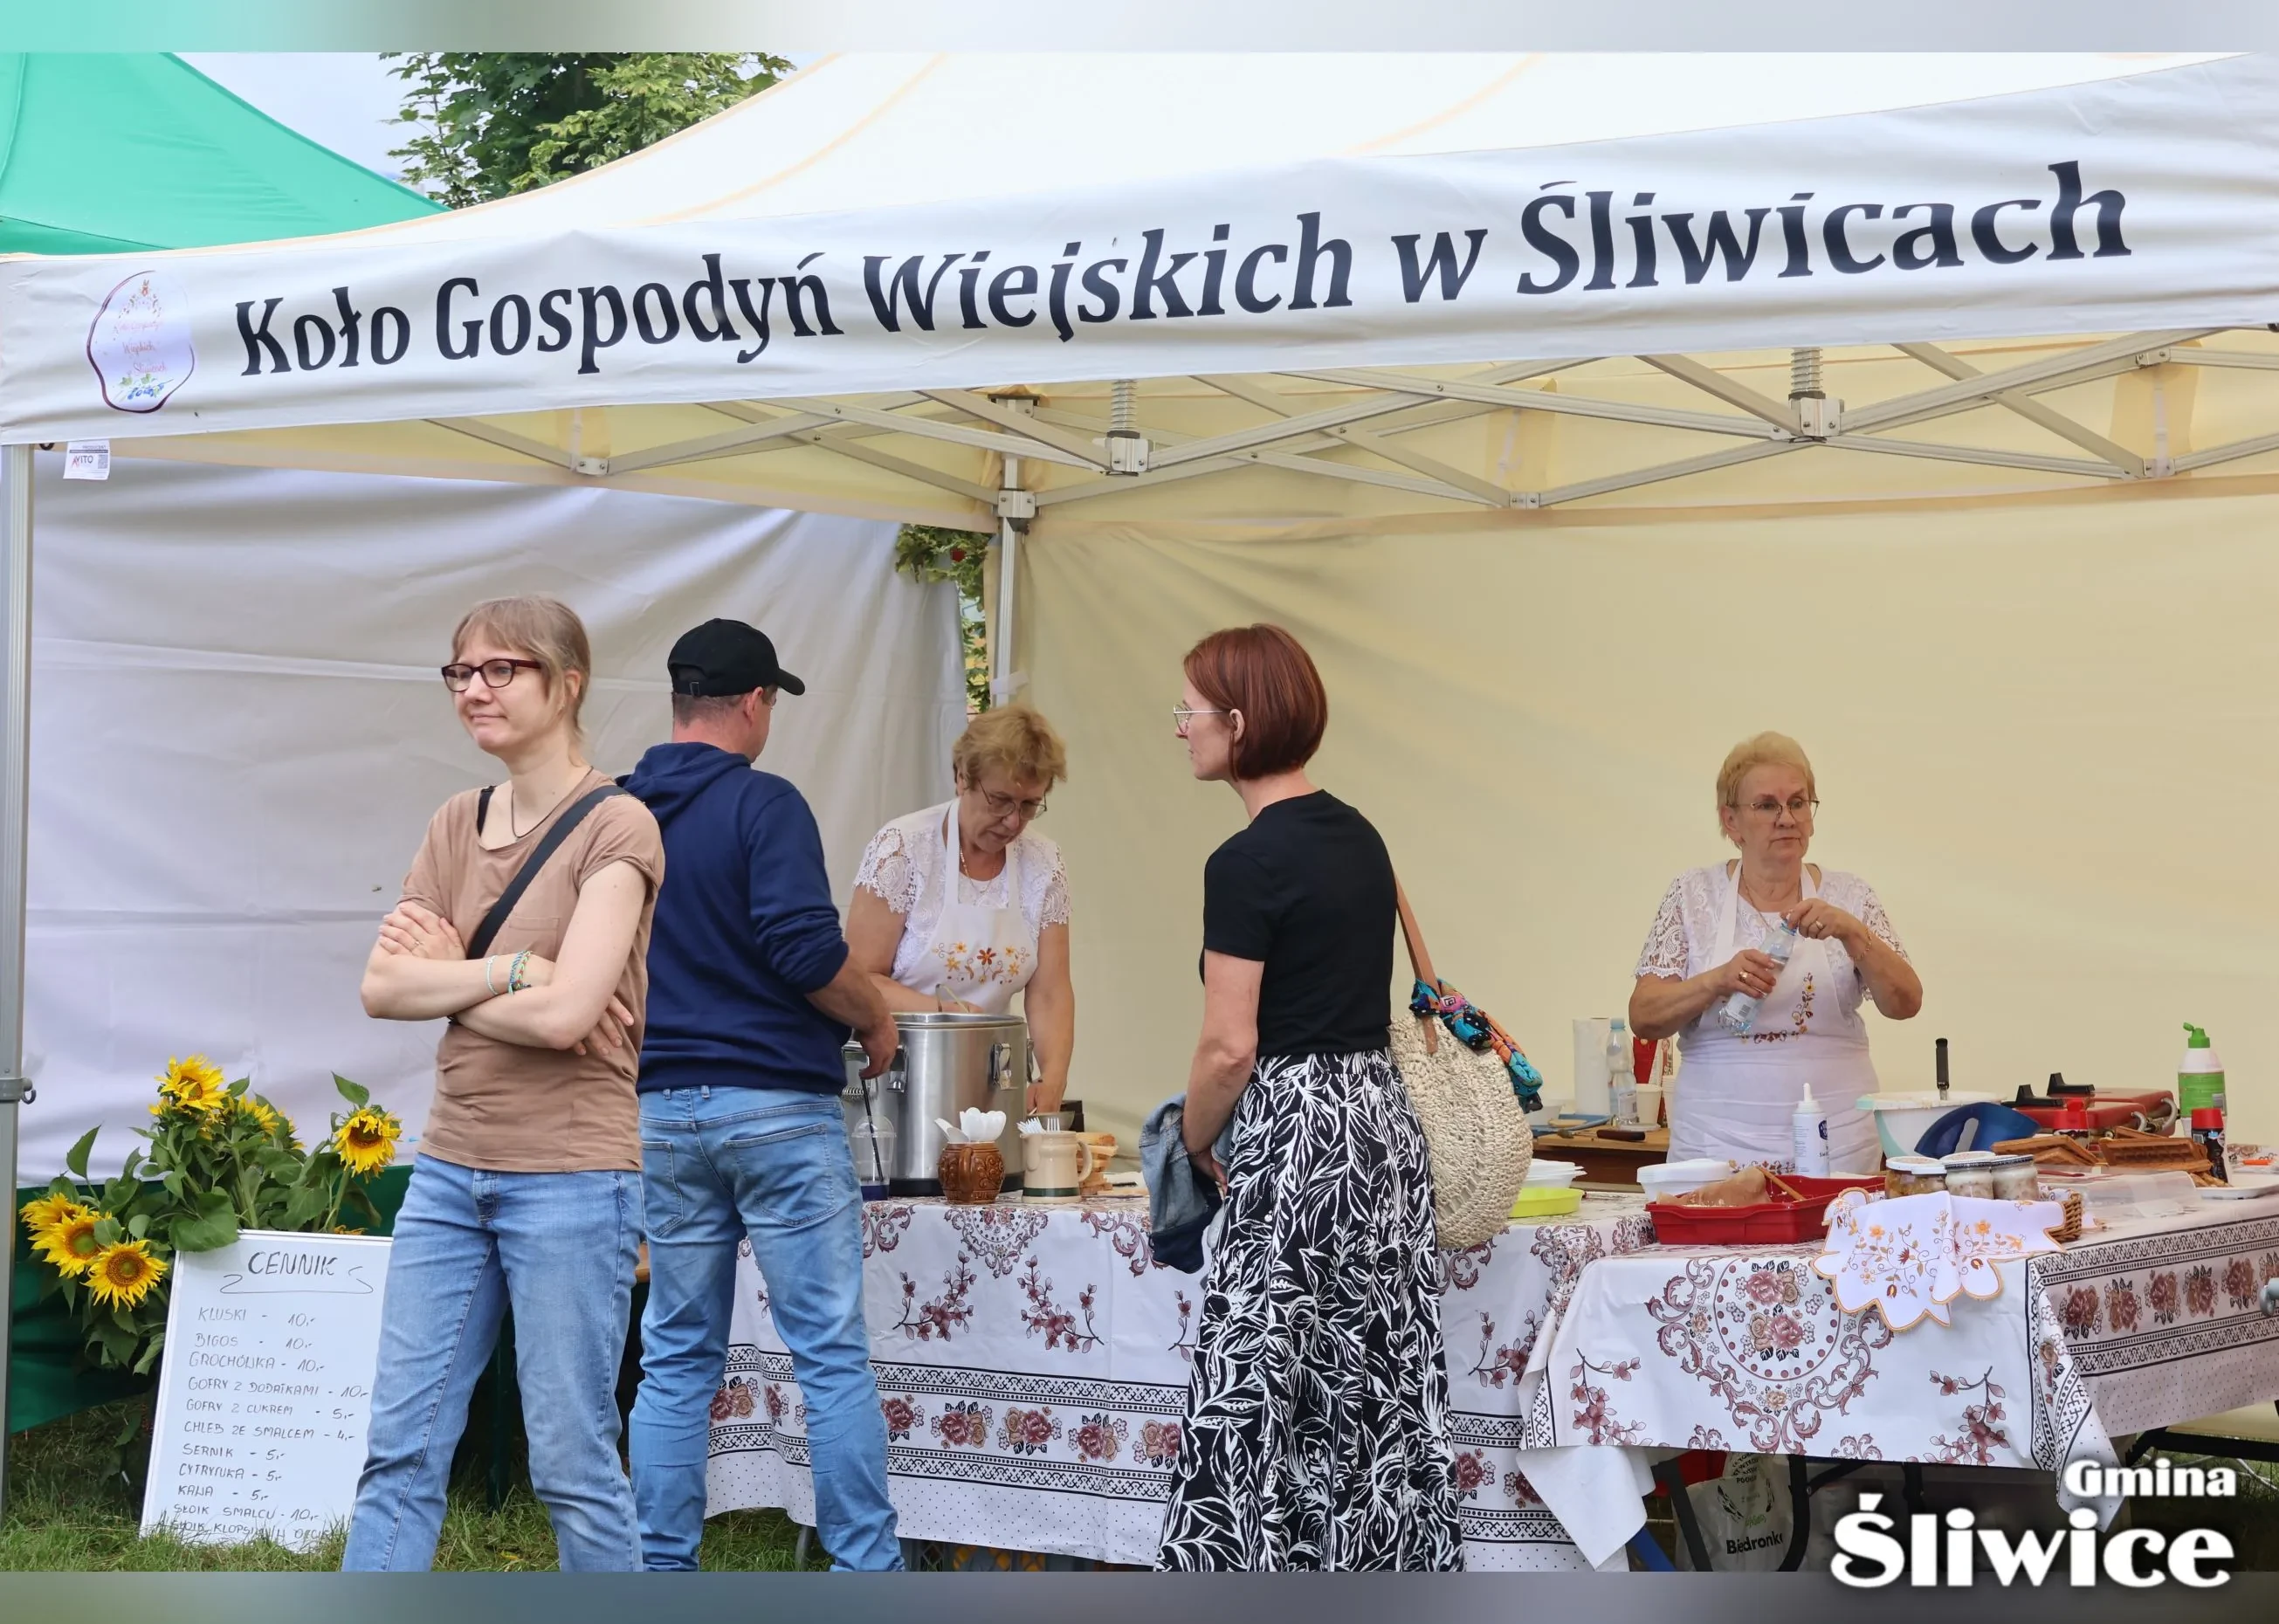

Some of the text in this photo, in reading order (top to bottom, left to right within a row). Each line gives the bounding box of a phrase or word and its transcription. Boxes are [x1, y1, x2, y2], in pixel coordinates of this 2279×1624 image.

[236, 160, 2133, 375] Koło Gospodyń Wiejskich w Śliwicach
[248, 1251, 339, 1276] CENNIK
[198, 1307, 246, 1321] KLUSKI
[195, 1332, 238, 1347] BIGOS
[189, 1377, 228, 1391] GOFRY
[248, 1381, 319, 1395] DODATKAMI
[186, 1398, 223, 1411] GOFRY
[246, 1404, 293, 1415] CUKREM
[184, 1421, 224, 1434] CHLEB
[252, 1426, 314, 1439] SMALCEM
[182, 1443, 233, 1457] SERNIK
[179, 1463, 244, 1479] CYTRYNKA
[177, 1485, 214, 1497] KAWA
[174, 1504, 210, 1515] SŁOIK
[223, 1506, 276, 1520] SMALCU
